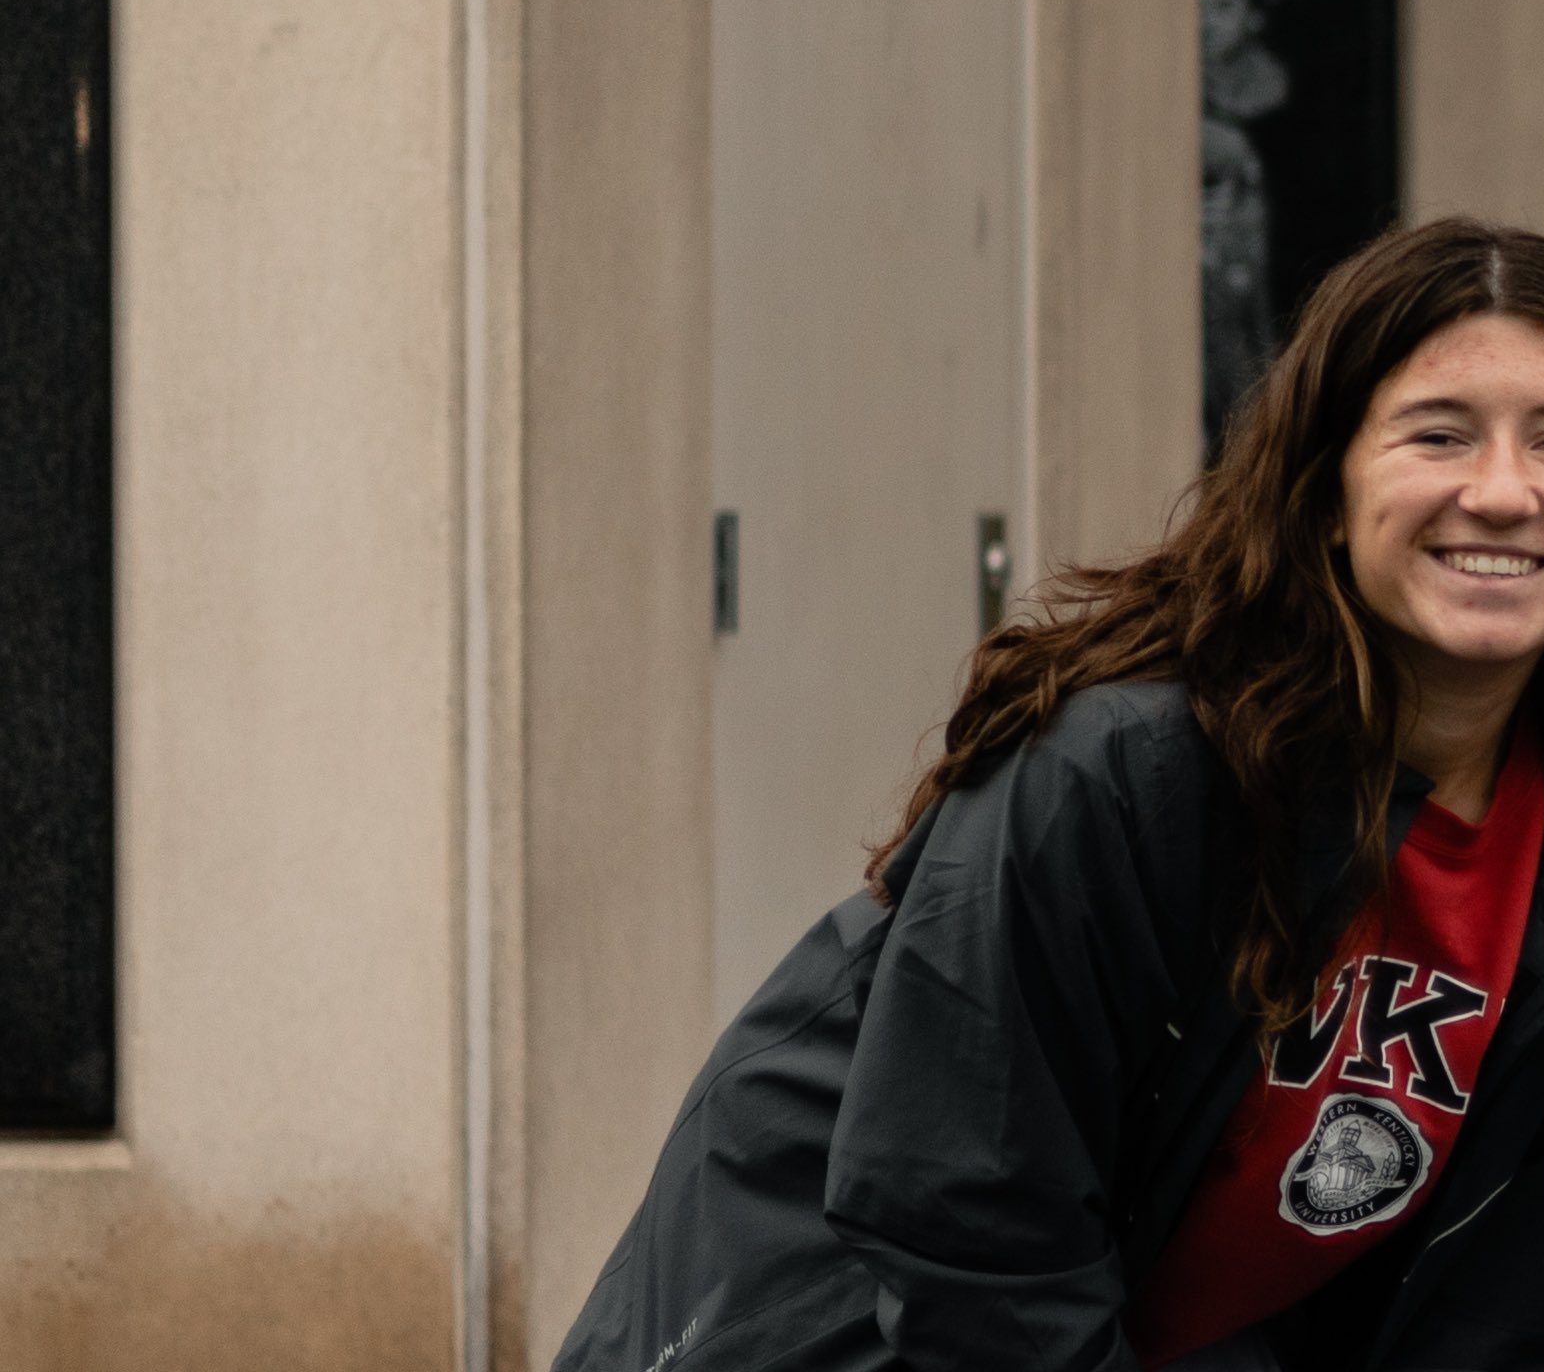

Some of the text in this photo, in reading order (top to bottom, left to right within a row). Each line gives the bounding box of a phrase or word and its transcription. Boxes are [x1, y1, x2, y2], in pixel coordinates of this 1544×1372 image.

[1307, 1103, 1416, 1167] WESTERN KENTUCKY
[1294, 1201, 1375, 1225] UNIVERSITY
